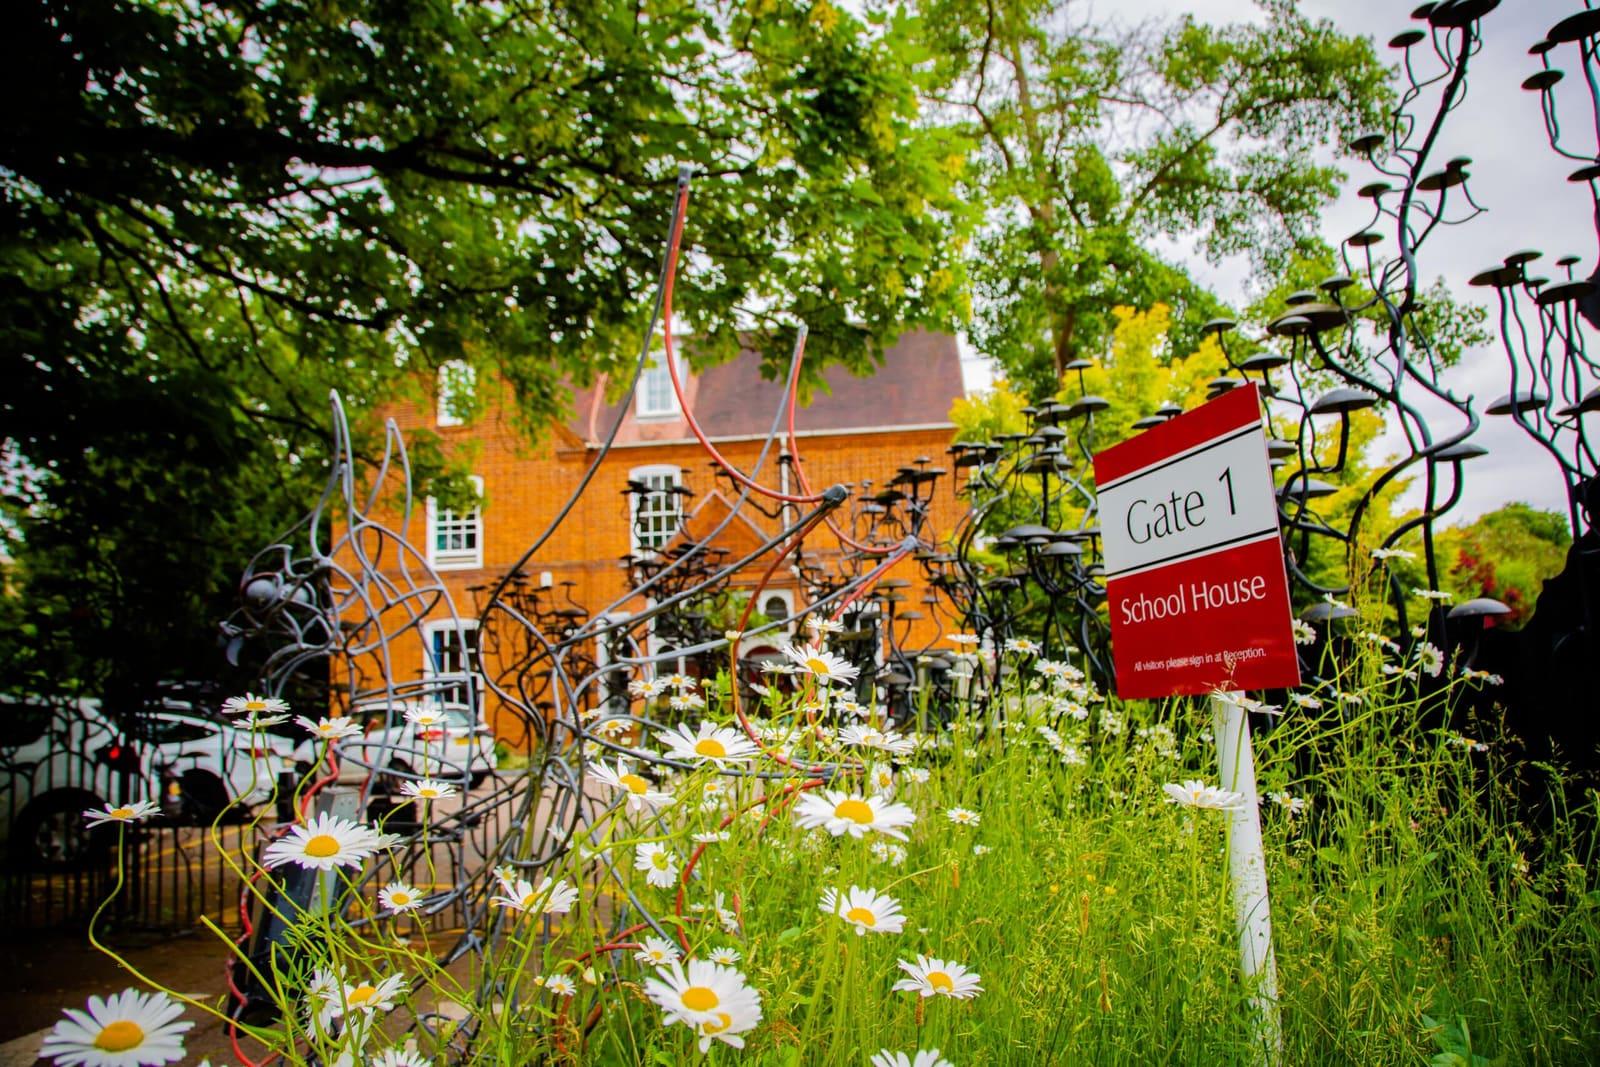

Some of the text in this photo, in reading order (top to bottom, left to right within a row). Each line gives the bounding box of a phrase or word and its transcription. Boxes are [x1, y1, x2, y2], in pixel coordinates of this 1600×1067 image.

[1127, 466, 1236, 544] Gate 1
[1121, 574, 1265, 625] School House
[1134, 661, 1142, 672] All
[1143, 660, 1165, 671] visitors
[1166, 656, 1188, 671] please
[1189, 654, 1204, 668] sign
[1205, 653, 1213, 663] in
[1214, 652, 1222, 662] at
